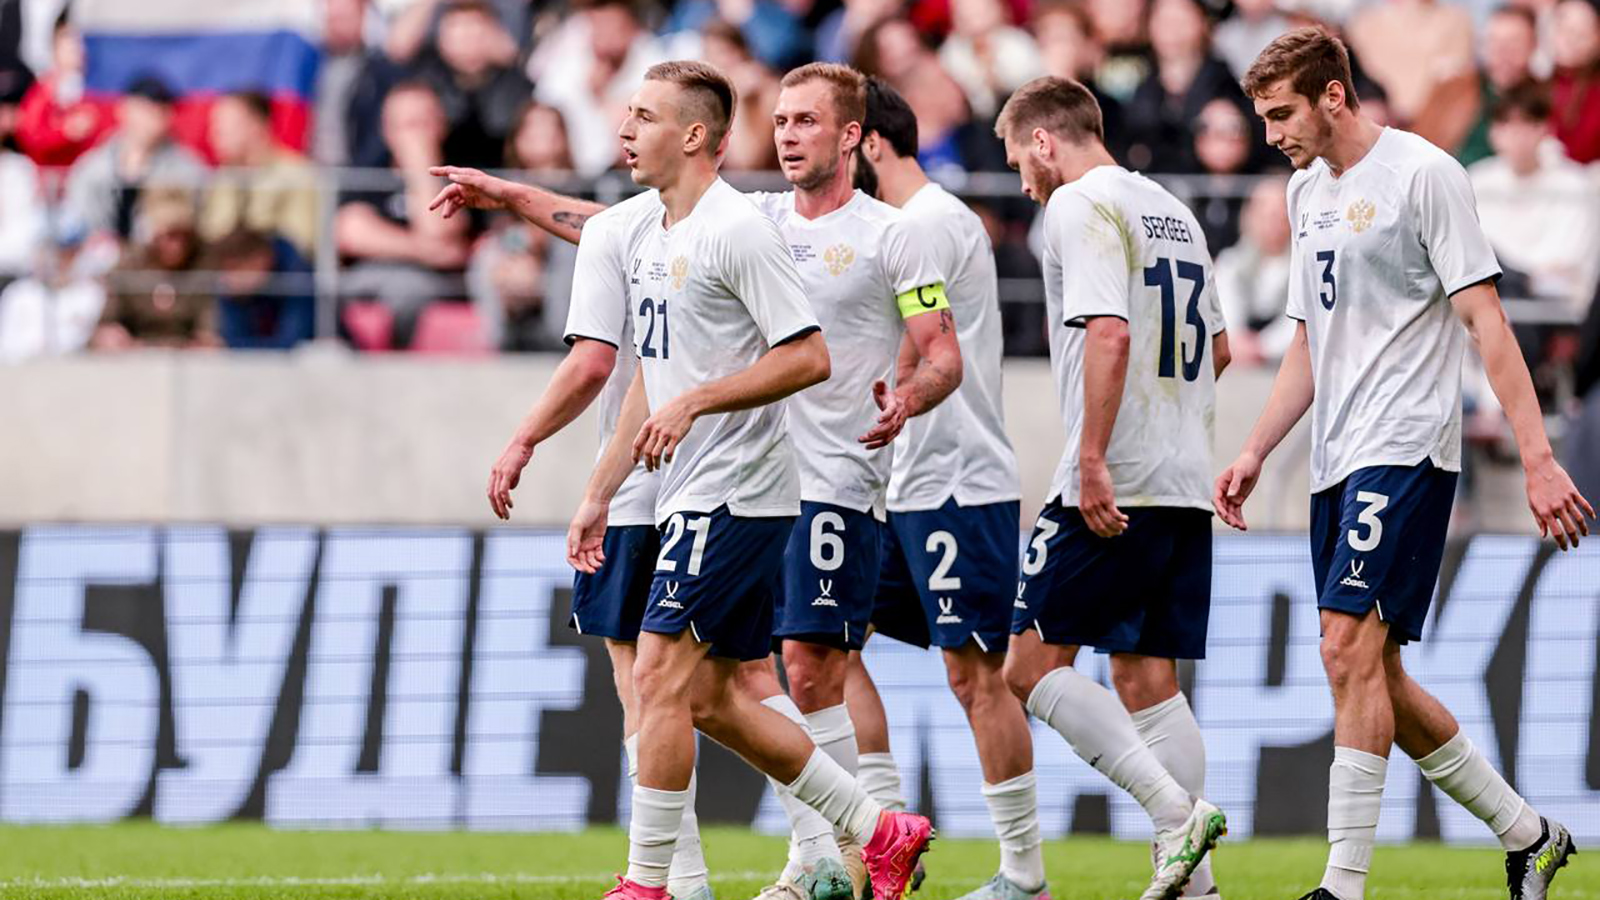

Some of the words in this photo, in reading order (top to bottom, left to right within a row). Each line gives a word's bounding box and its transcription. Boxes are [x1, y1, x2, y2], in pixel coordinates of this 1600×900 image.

[917, 284, 937, 309] C
[1316, 250, 1336, 310] 3
[639, 297, 669, 359] 21
[1144, 257, 1206, 382] 13
[656, 513, 711, 576] 21
[809, 511, 846, 571] 6
[1347, 490, 1389, 552] 3
[925, 530, 961, 591] 2
[0, 524, 690, 832] БУДЕ
